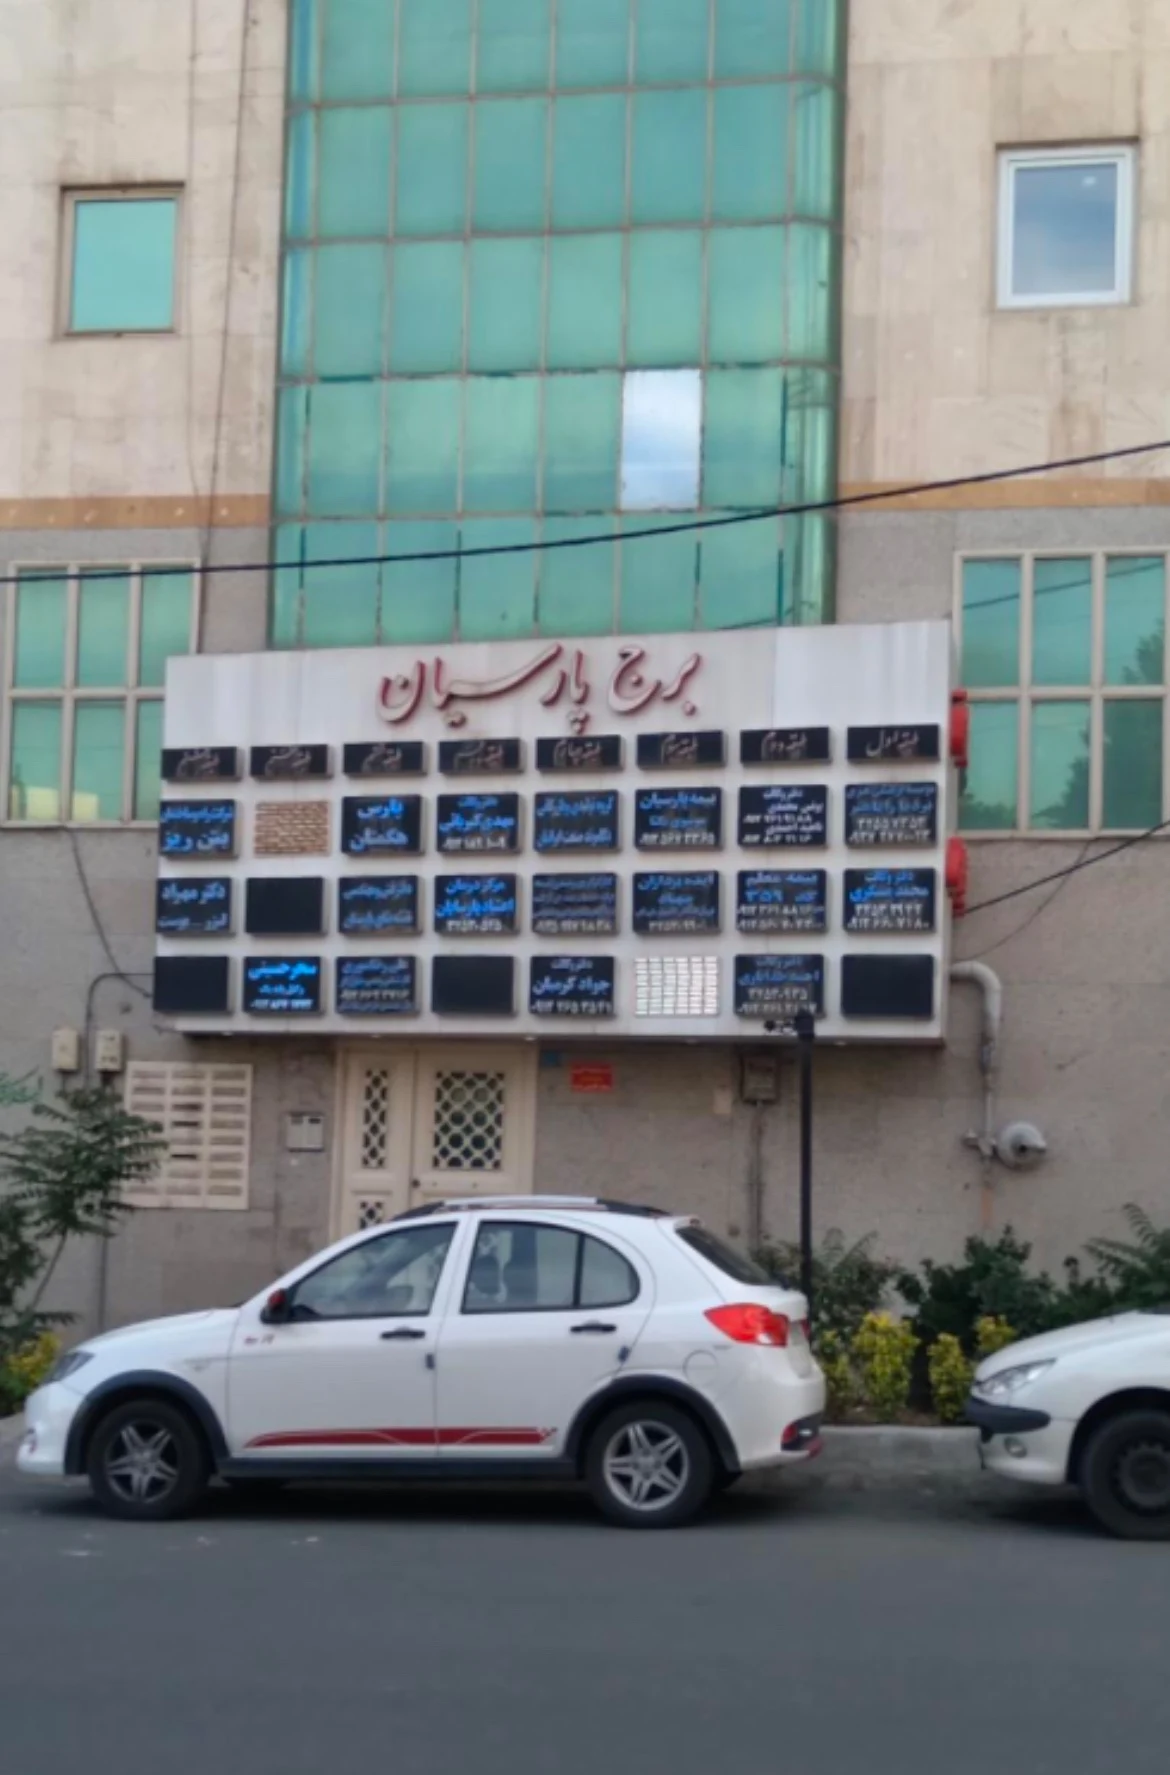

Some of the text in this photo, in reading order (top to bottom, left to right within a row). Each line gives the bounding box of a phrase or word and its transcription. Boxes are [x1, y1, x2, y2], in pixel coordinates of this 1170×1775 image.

[376, 643, 701, 735] برج پارسیان
[866, 729, 899, 757] اول
